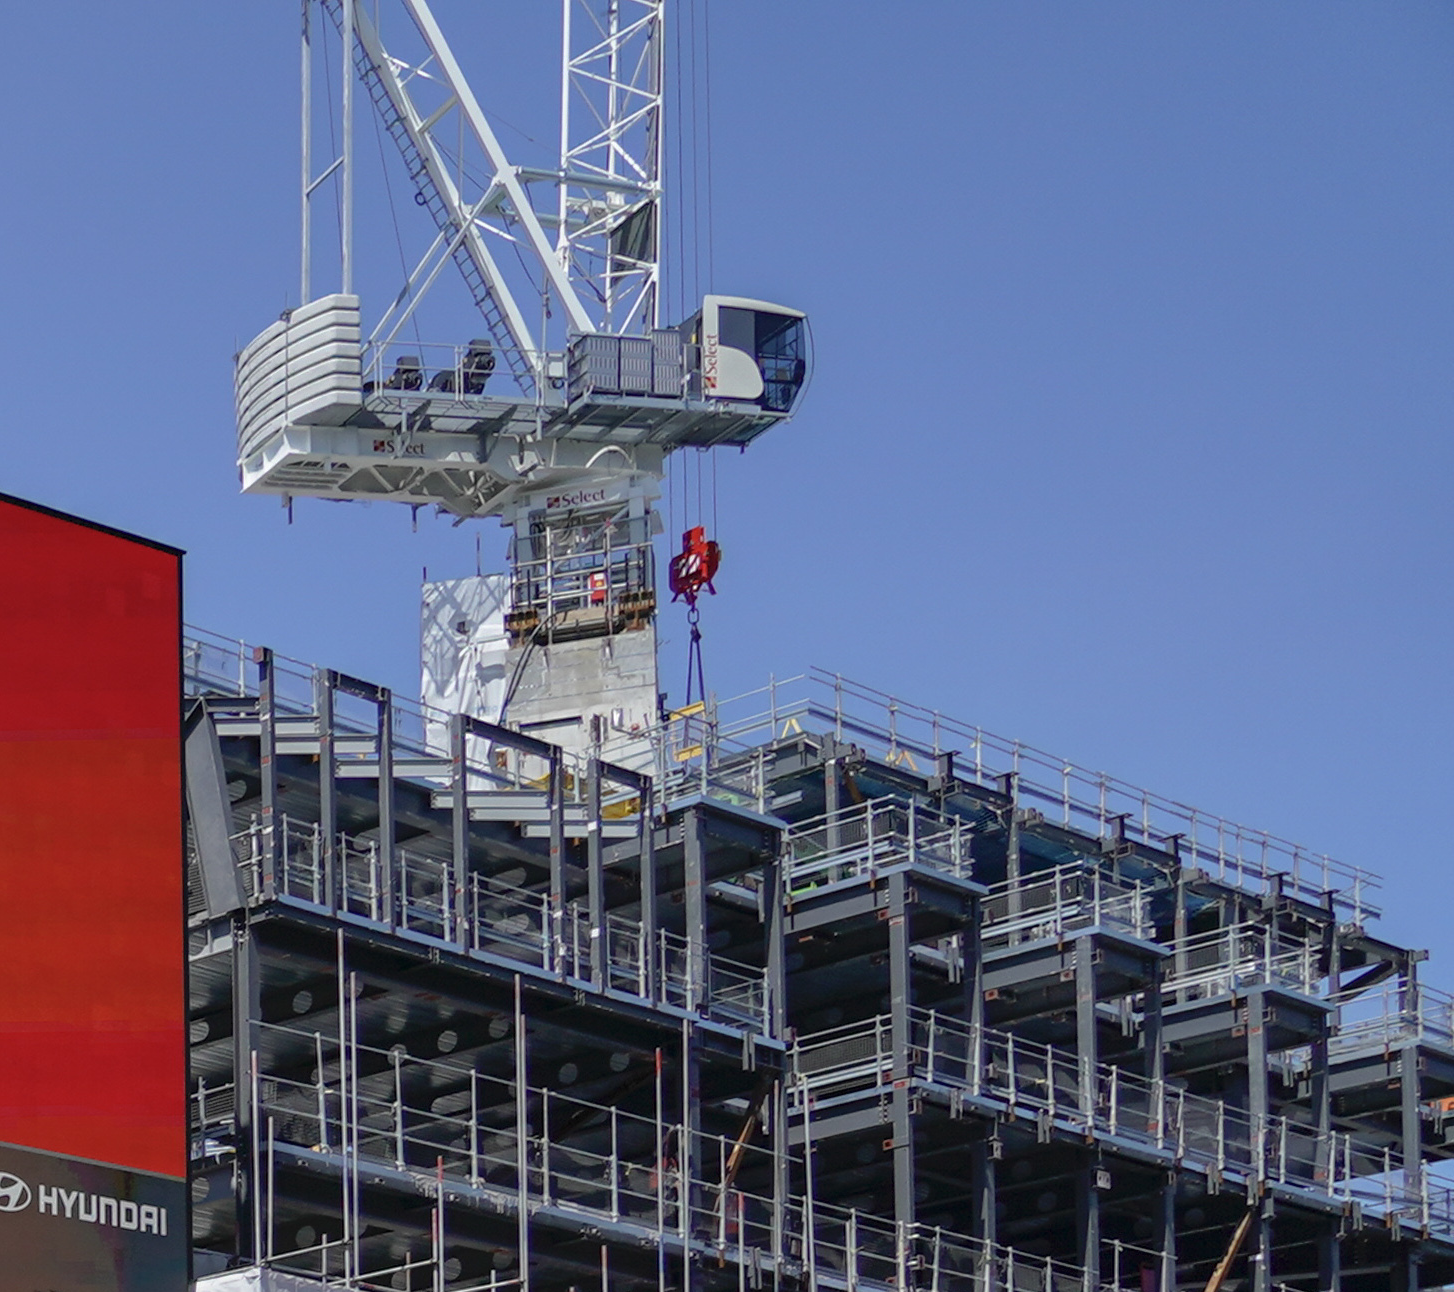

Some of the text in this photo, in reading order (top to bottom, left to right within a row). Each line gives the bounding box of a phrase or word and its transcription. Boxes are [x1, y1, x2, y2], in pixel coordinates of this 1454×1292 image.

[386, 440, 425, 455] Sect
[562, 488, 606, 507] Select
[38, 1184, 168, 1238] HYUNDAI
